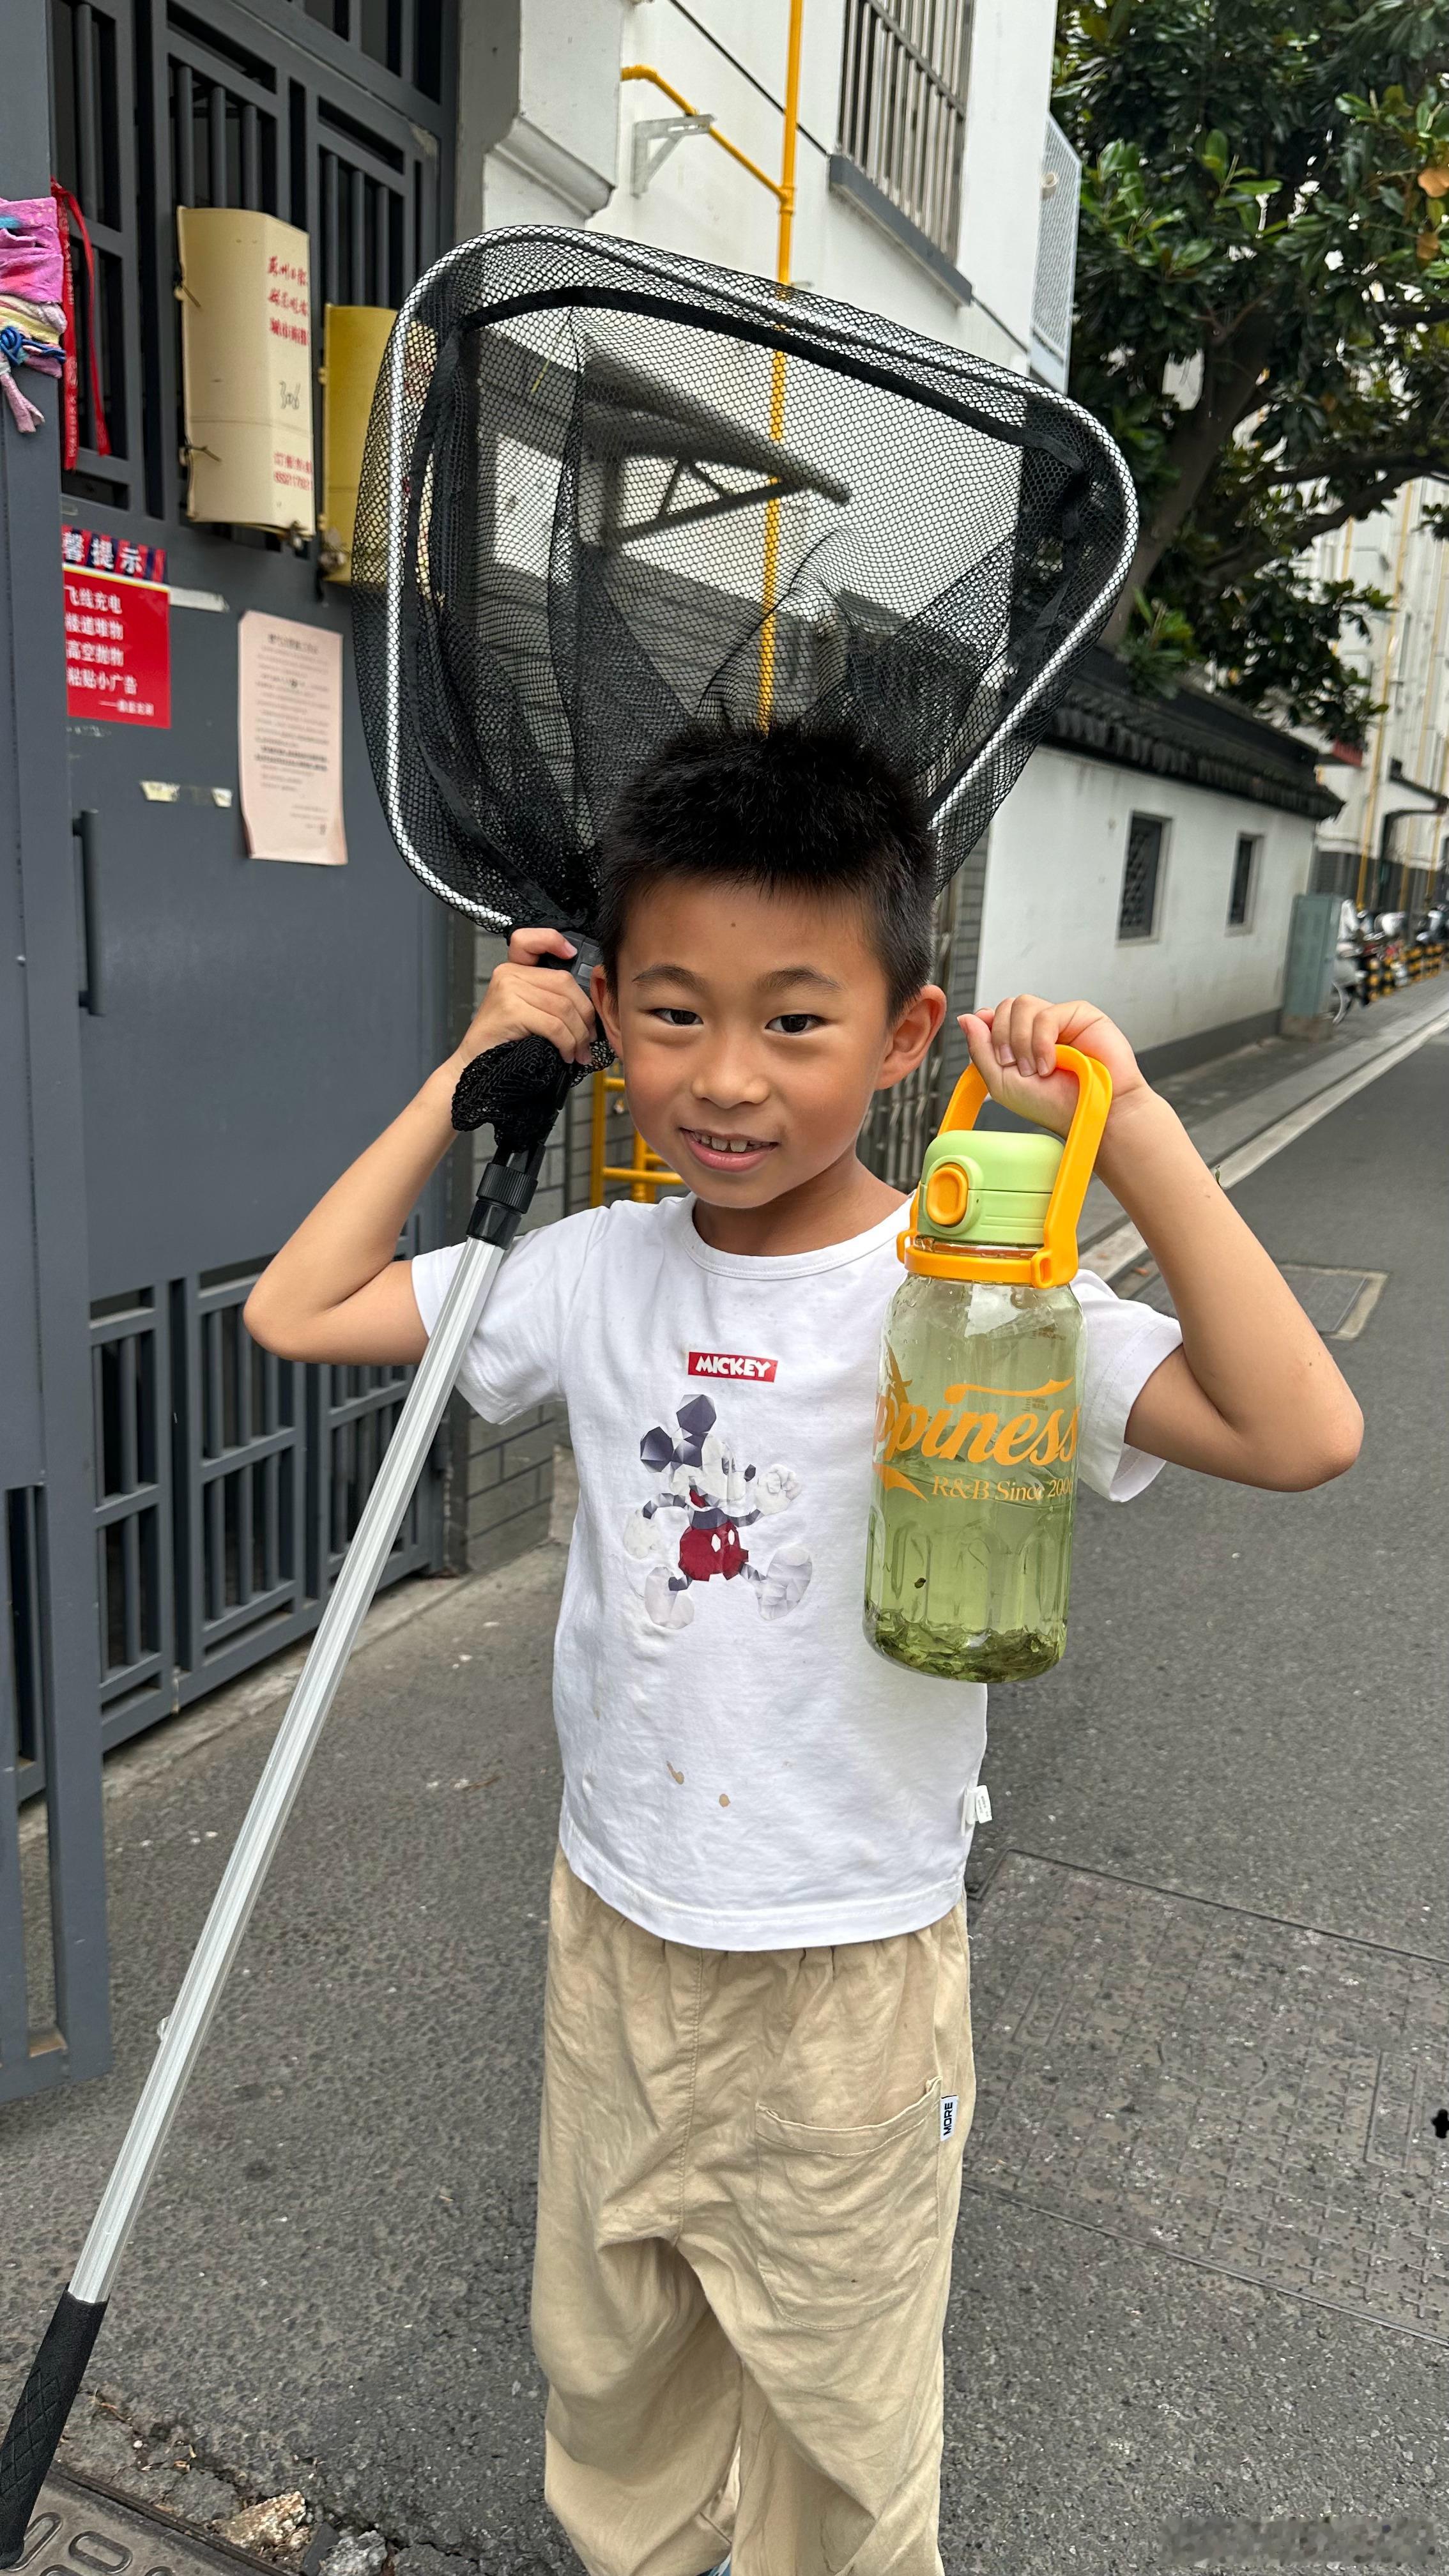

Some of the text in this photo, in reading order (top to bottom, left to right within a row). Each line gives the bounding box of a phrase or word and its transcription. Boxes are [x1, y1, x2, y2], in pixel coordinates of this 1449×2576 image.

[64, 585, 123, 615] 飞线充电
[66, 639, 125, 667] 高空抛物
[66, 666, 138, 695] 粘贴小广告
[695, 1355, 771, 1377] MICKEY
[931, 1475, 990, 1499] R&B
[943, 2102, 953, 2136] MORE
